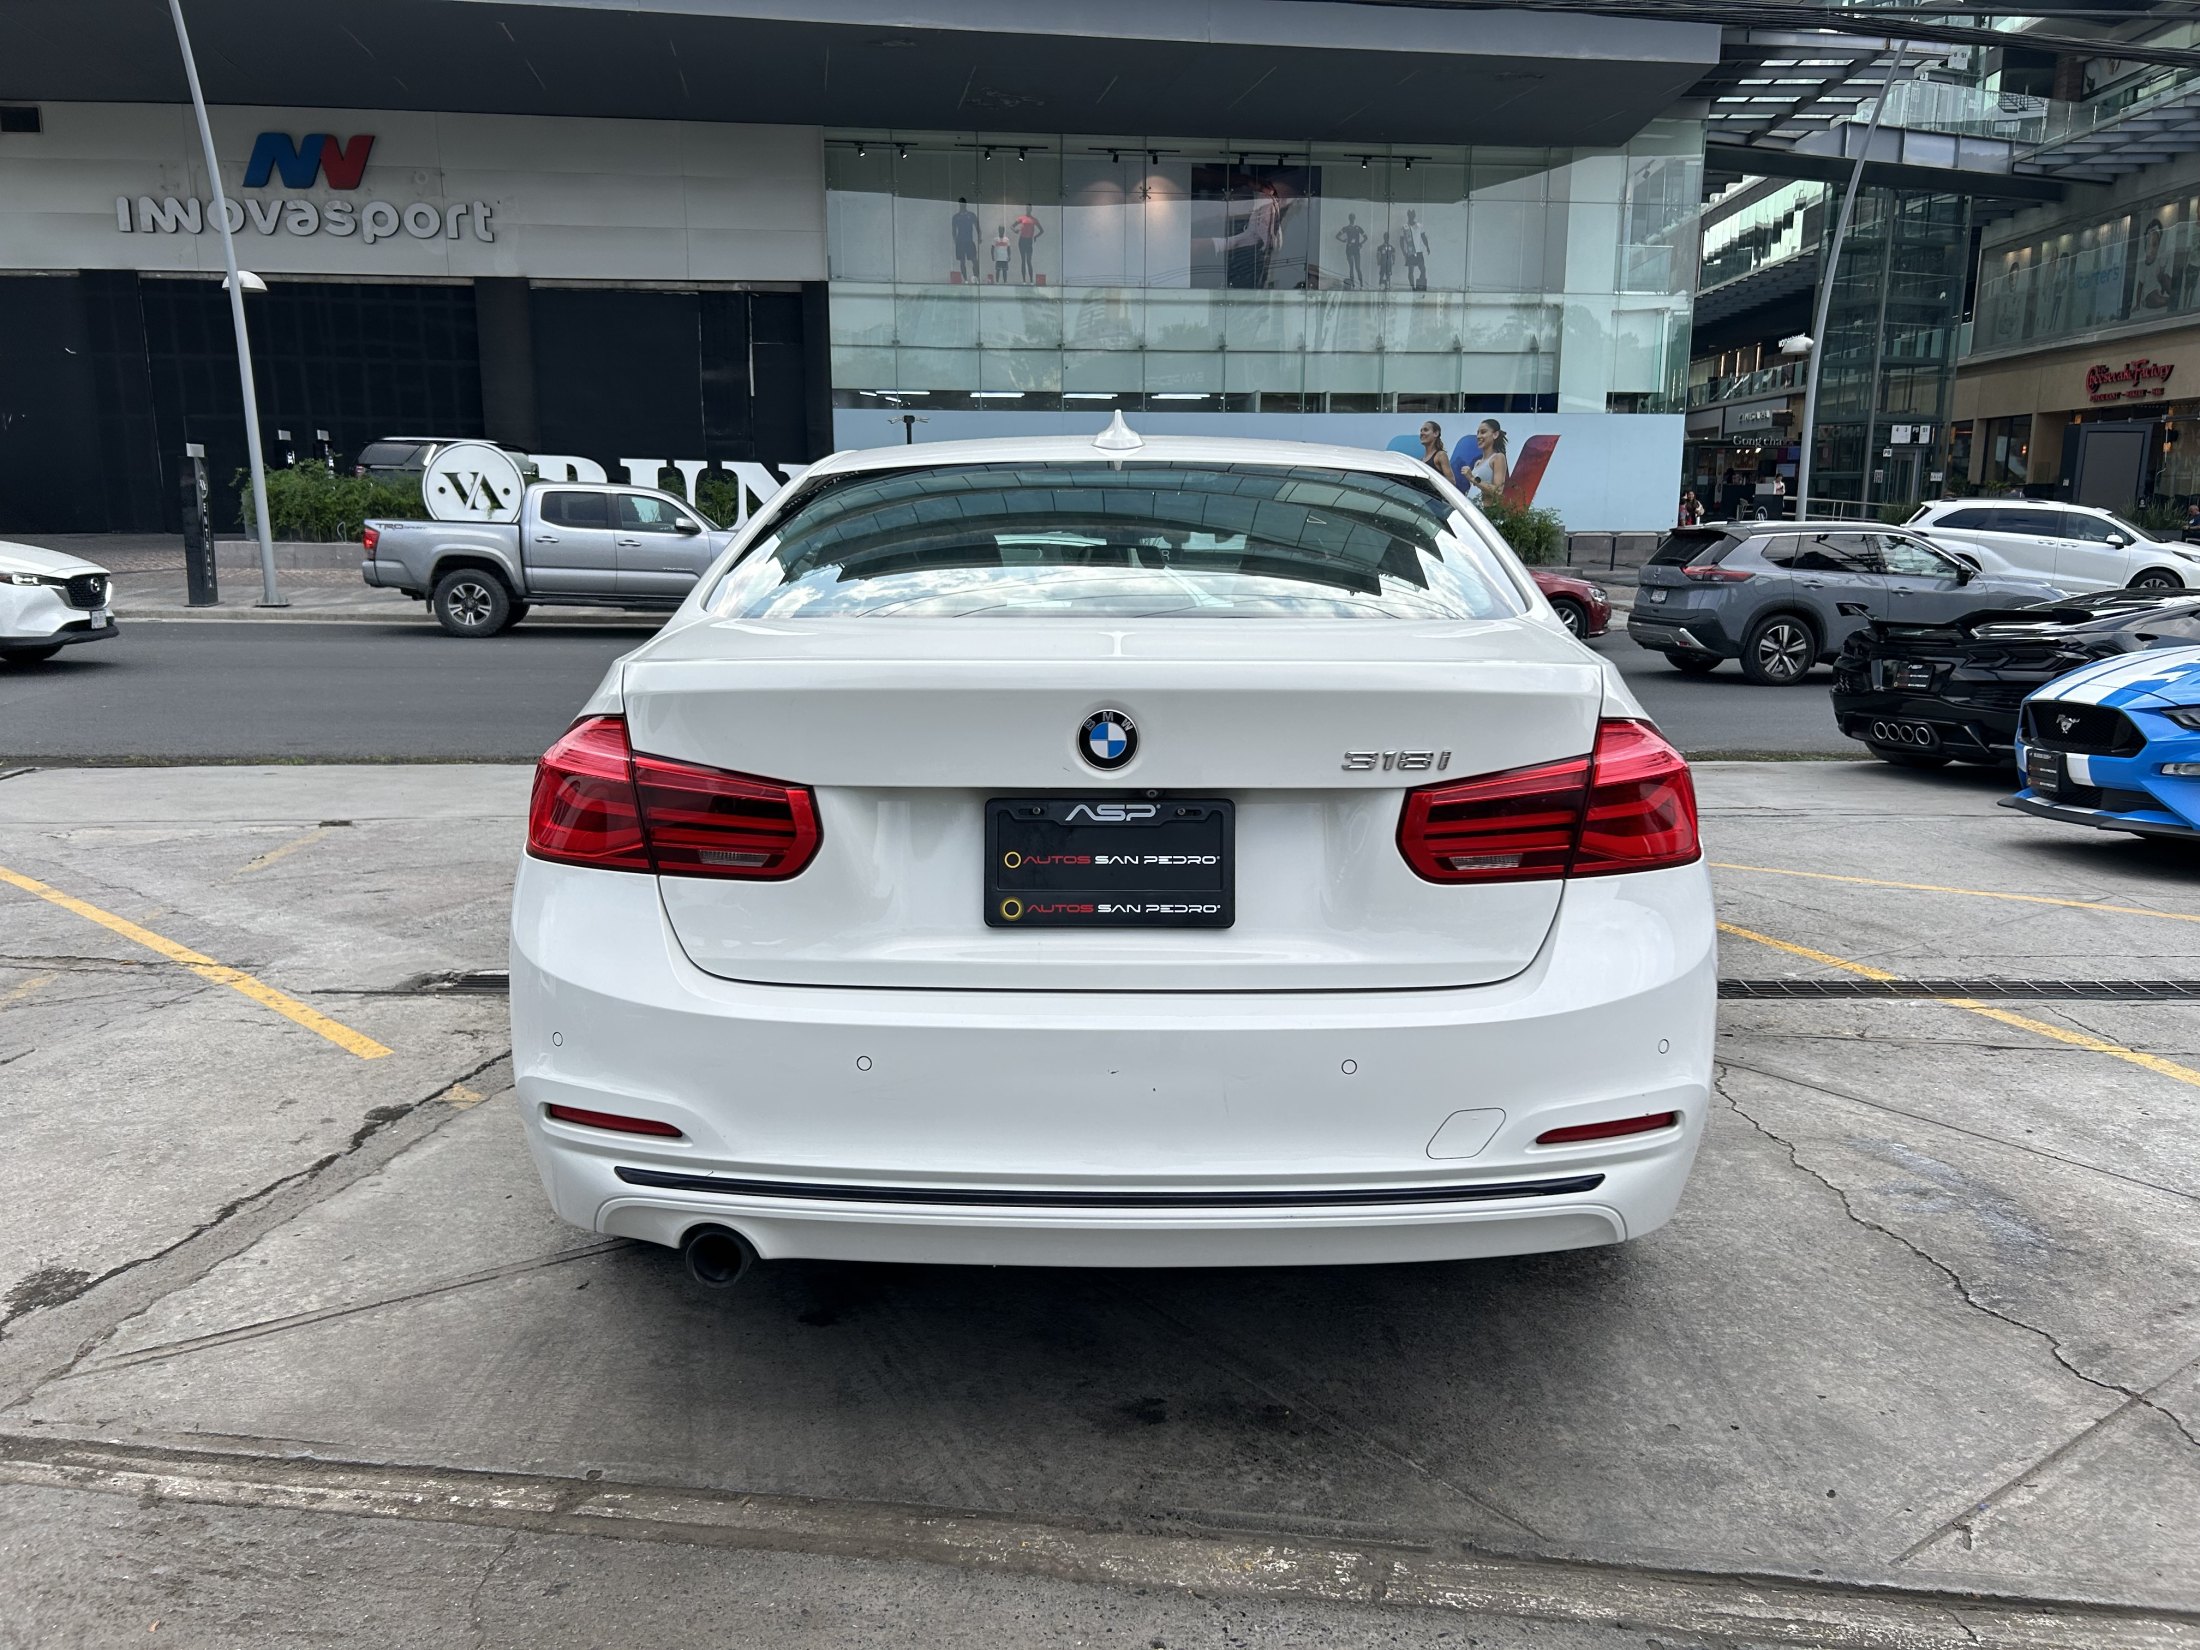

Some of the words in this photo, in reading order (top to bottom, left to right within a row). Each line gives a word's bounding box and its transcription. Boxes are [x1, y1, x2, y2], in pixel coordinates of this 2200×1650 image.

[1733, 435, 1761, 448] Gong
[1763, 435, 1782, 446] cha
[1083, 711, 1134, 732] BMW
[1341, 750, 1452, 771] 318i
[1023, 855, 1092, 865] AUTOS
[1095, 855, 1139, 865] SAN
[1143, 855, 1218, 865] PEDRO
[1027, 903, 1094, 913] AUTOS
[1097, 903, 1141, 913] SAN
[1145, 903, 1218, 913] PEDRO
